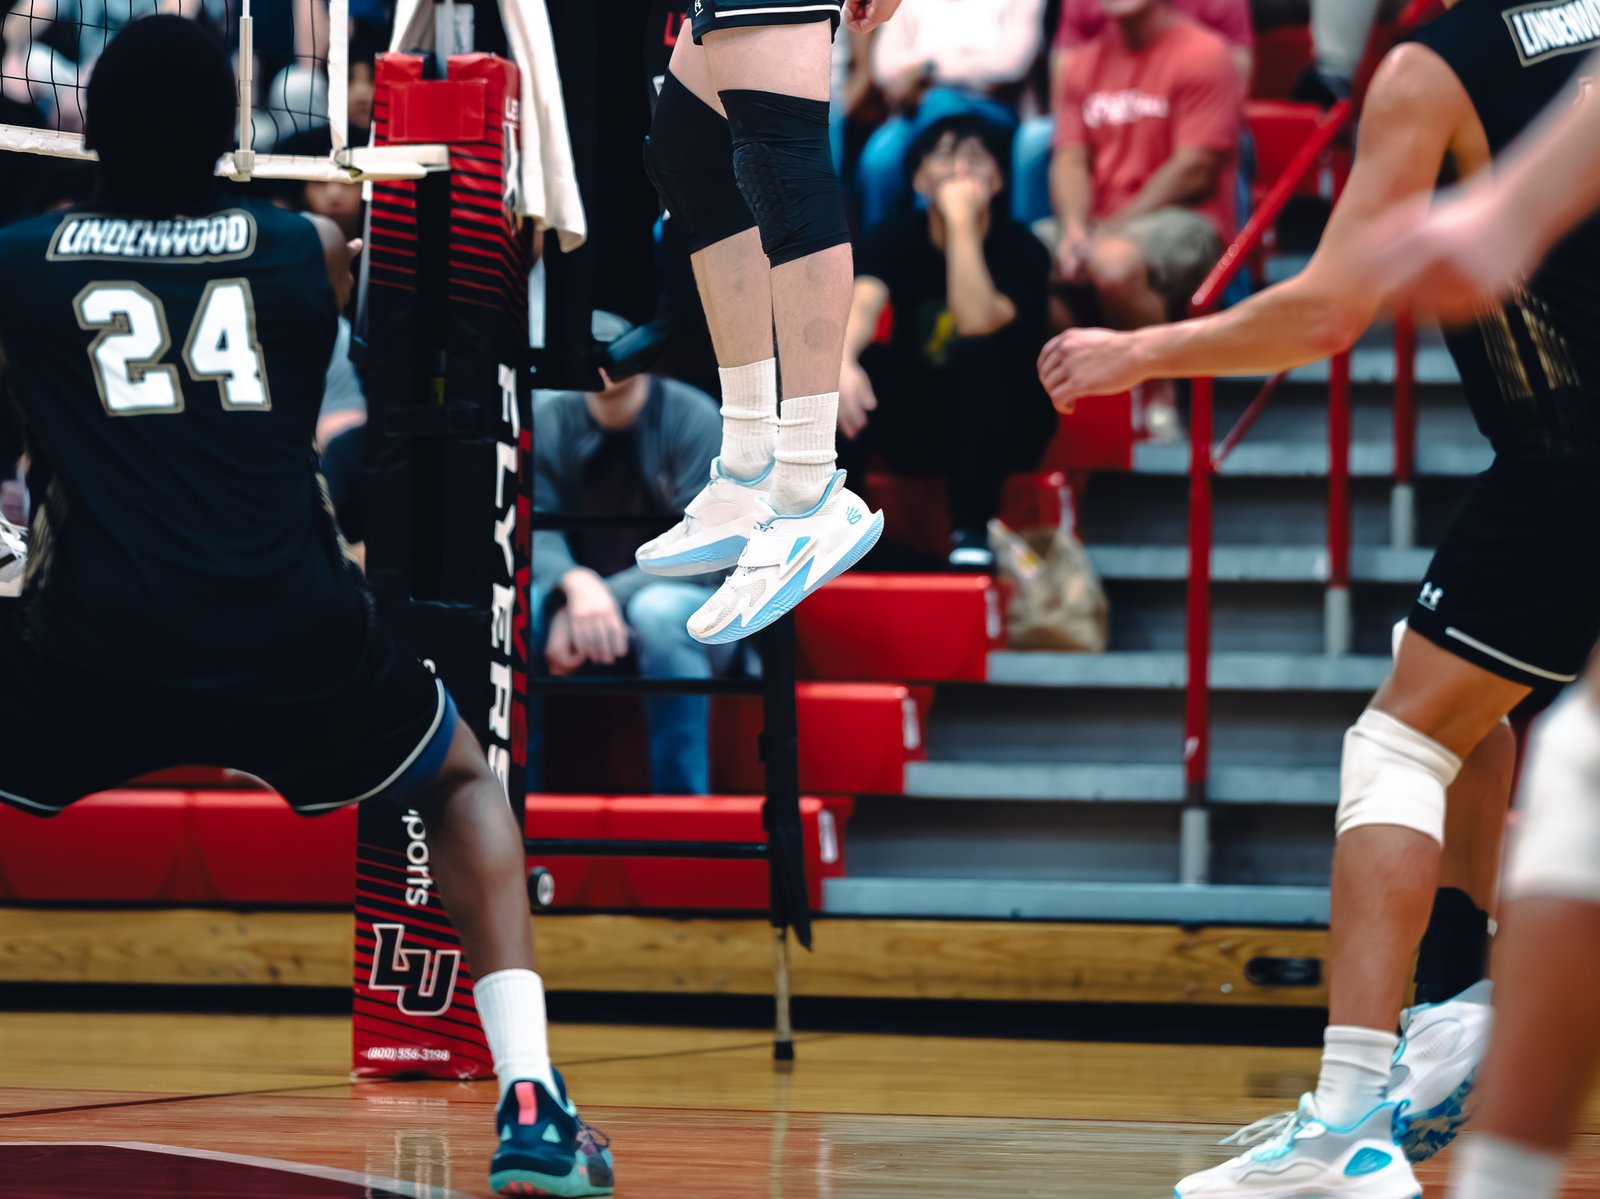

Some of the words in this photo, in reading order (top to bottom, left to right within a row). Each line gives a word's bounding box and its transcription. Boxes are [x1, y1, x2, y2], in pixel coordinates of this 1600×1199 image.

[57, 213, 250, 257] LINDENWOOD
[73, 278, 272, 416] 24
[487, 362, 520, 805] FLYERS
[510, 427, 532, 767] LEWIS
[401, 809, 433, 907] ports
[368, 922, 462, 1017] LU
